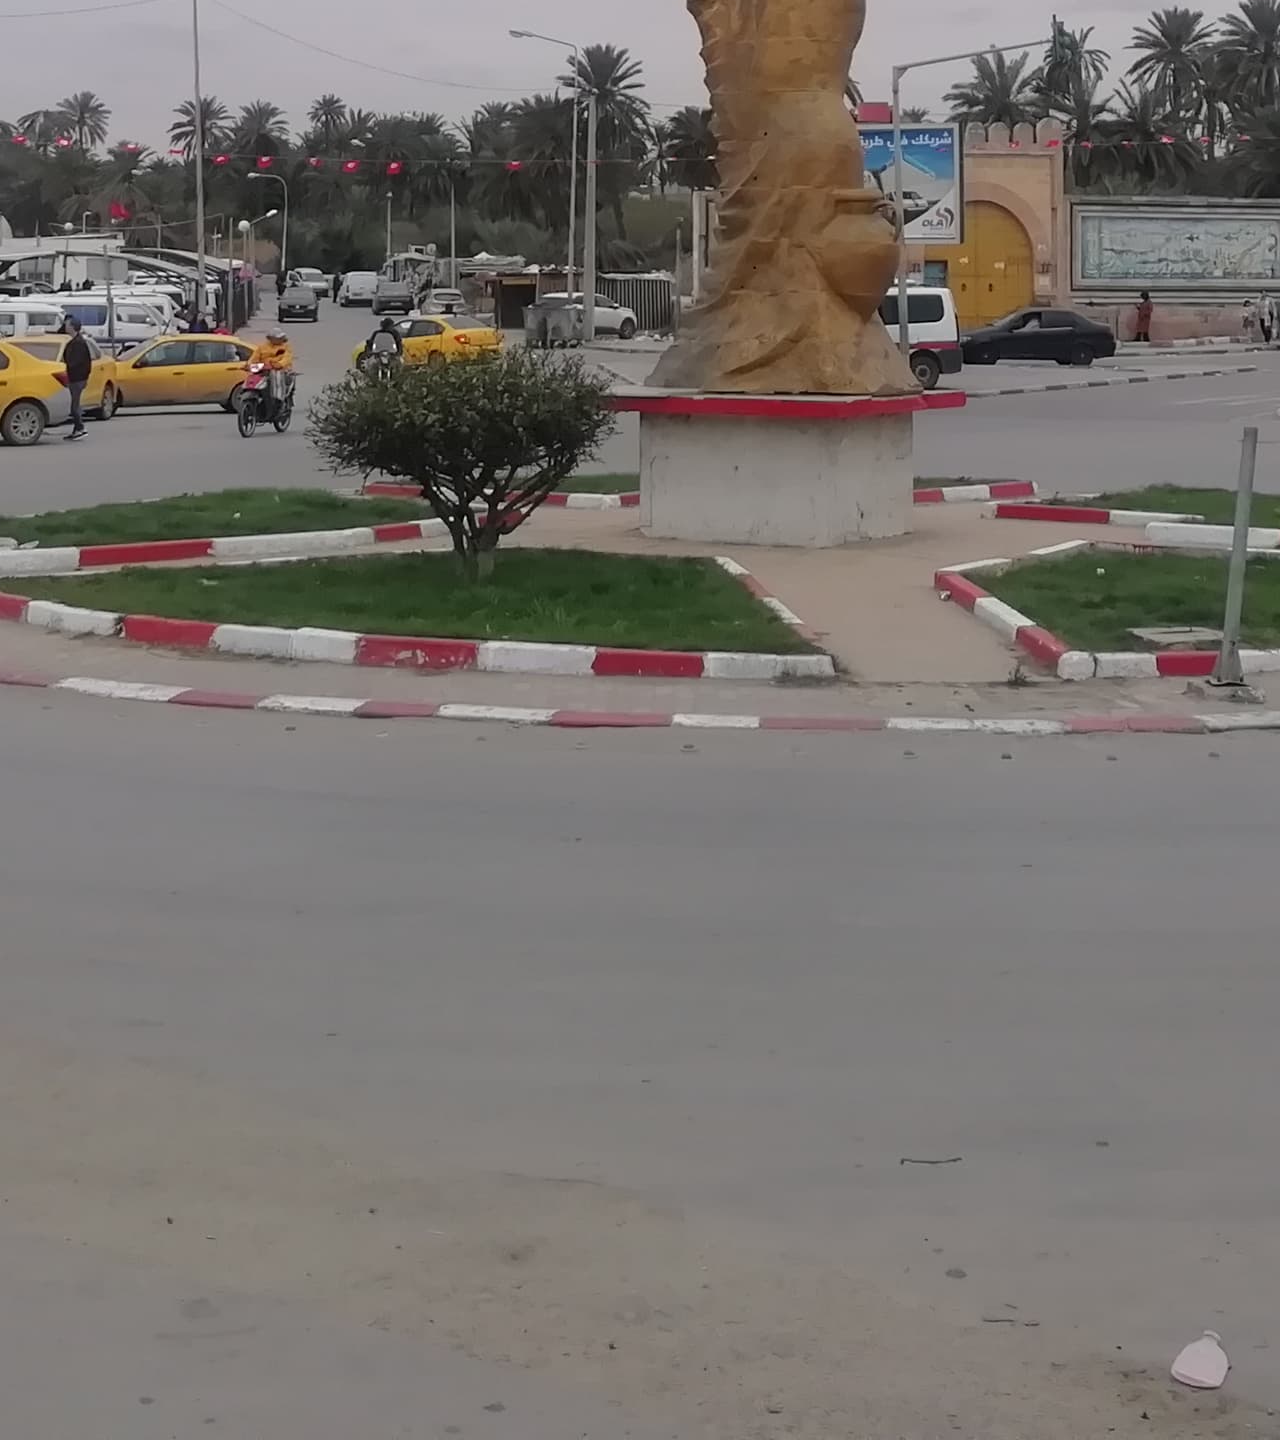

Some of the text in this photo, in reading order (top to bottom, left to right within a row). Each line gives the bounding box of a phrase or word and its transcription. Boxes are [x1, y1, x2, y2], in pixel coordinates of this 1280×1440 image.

[887, 133, 908, 152] في
[911, 131, 952, 148] شريكك
[922, 219, 944, 228] OLA
